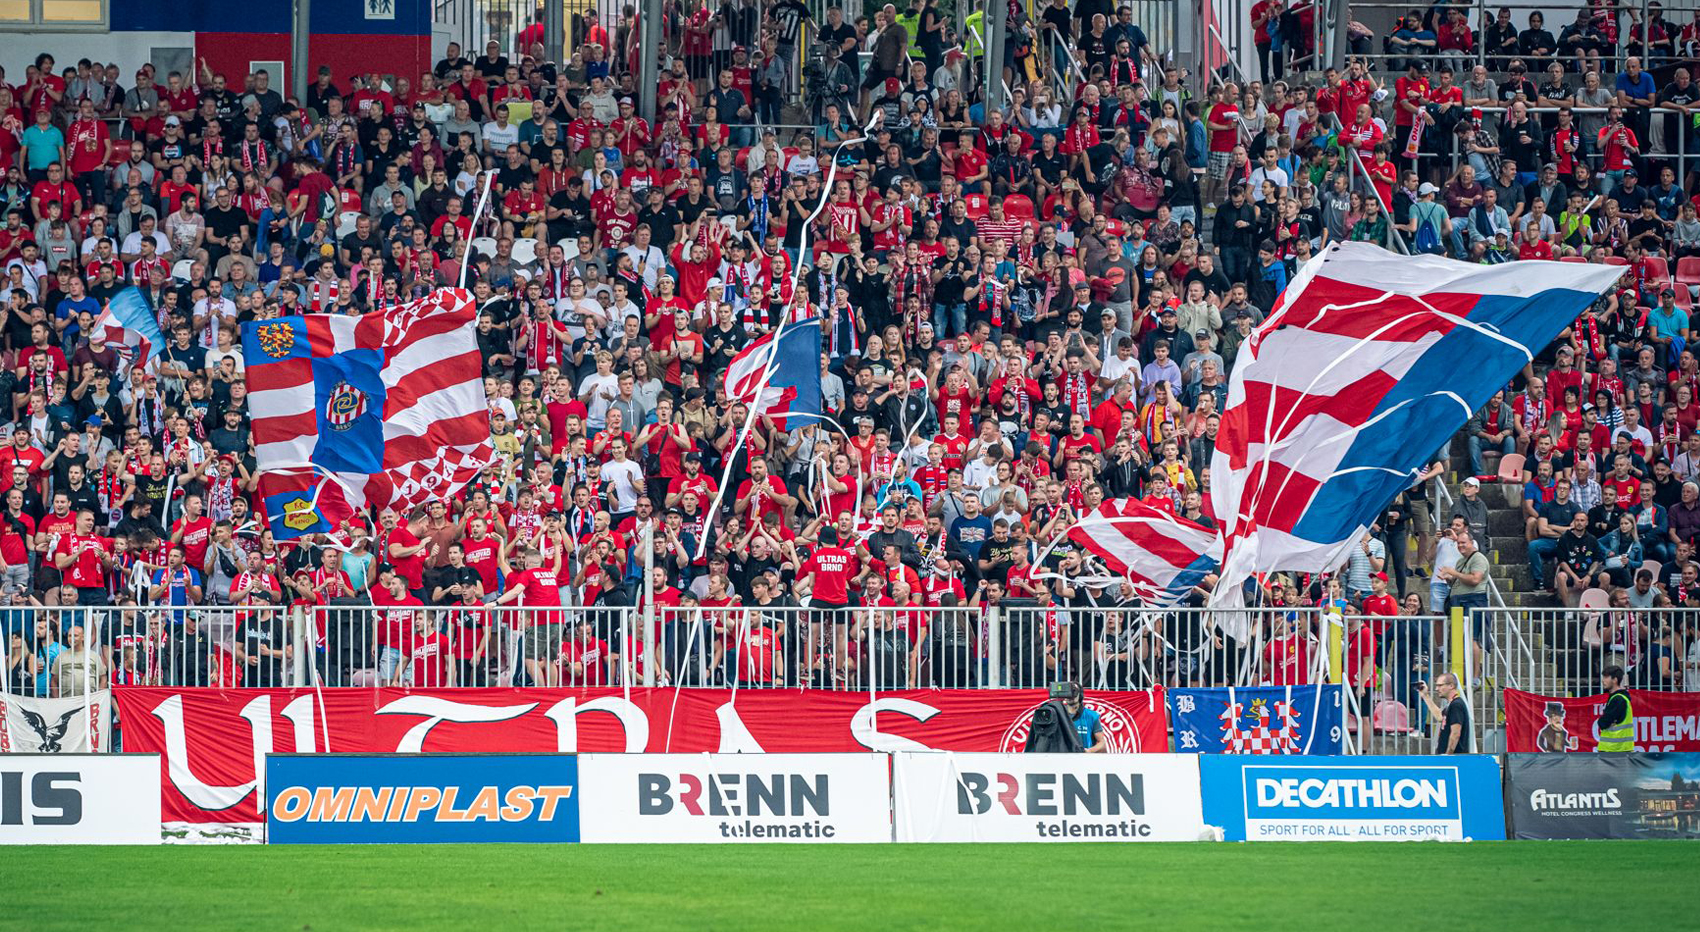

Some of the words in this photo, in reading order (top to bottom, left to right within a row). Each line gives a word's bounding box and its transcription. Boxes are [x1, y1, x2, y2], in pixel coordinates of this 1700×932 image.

[817, 555, 847, 564] ULTRAS
[821, 563, 843, 572] BRNO
[638, 773, 829, 816] BRENN
[957, 773, 1145, 816] BRENN
[1256, 778, 1448, 808] DECATHLON
[1530, 788, 1622, 811] ATLANTIS
[273, 785, 572, 823] OMNIPLAST
[719, 820, 835, 838] telematic
[1036, 820, 1151, 838] telematic
[1259, 824, 1298, 836] SPORT
[1302, 824, 1323, 836] FOR
[1328, 824, 1350, 836] ALL
[1359, 824, 1380, 836] ALL
[1385, 824, 1407, 836] FOR
[1410, 824, 1448, 837] SPORT
